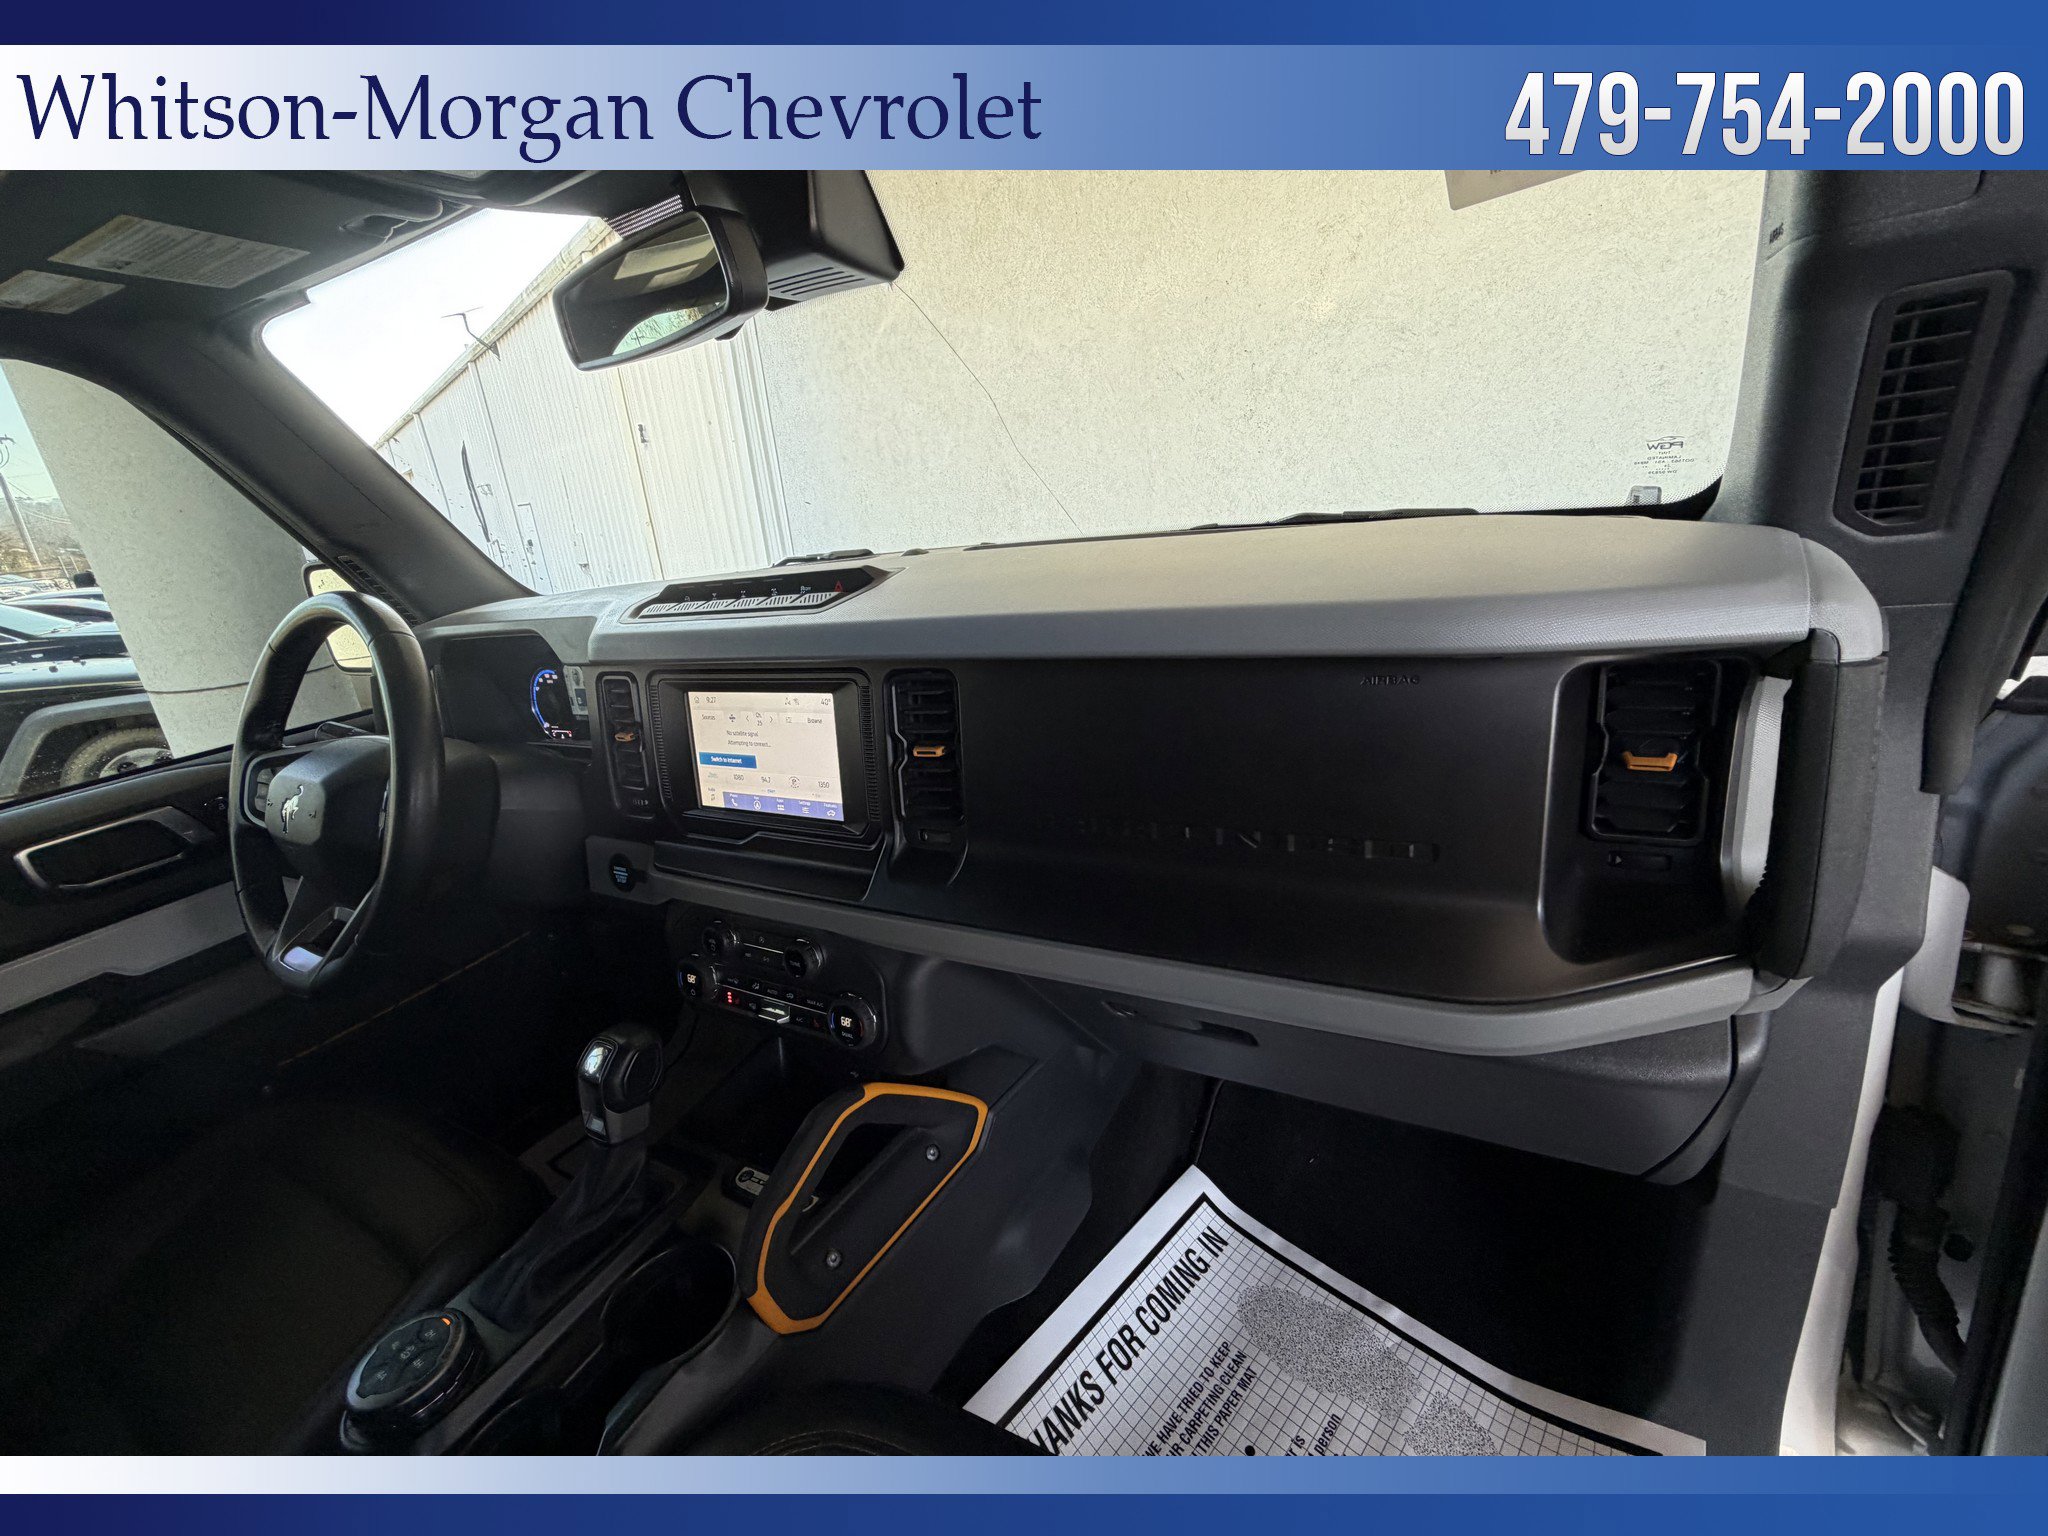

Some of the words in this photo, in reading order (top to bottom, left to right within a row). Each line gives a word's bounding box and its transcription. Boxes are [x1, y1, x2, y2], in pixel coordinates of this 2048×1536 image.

[1095, 1324, 1147, 1387] FOR
[1135, 1248, 1212, 1336] COMING
[1196, 1226, 1229, 1260] IN
[1156, 1411, 1183, 1445] HAVE
[1176, 1381, 1205, 1414] TRIED
[1199, 1366, 1215, 1383] TO
[1209, 1341, 1231, 1369] KEEP
[1179, 1383, 1226, 1446] CARPETING
[1219, 1350, 1248, 1386] CLEAN
[1194, 1424, 1220, 1454] THIS
[1214, 1389, 1244, 1428] PAPER
[1237, 1365, 1258, 1392] MAT
[1313, 1413, 1341, 1456] person
[1291, 1435, 1306, 1449] is
